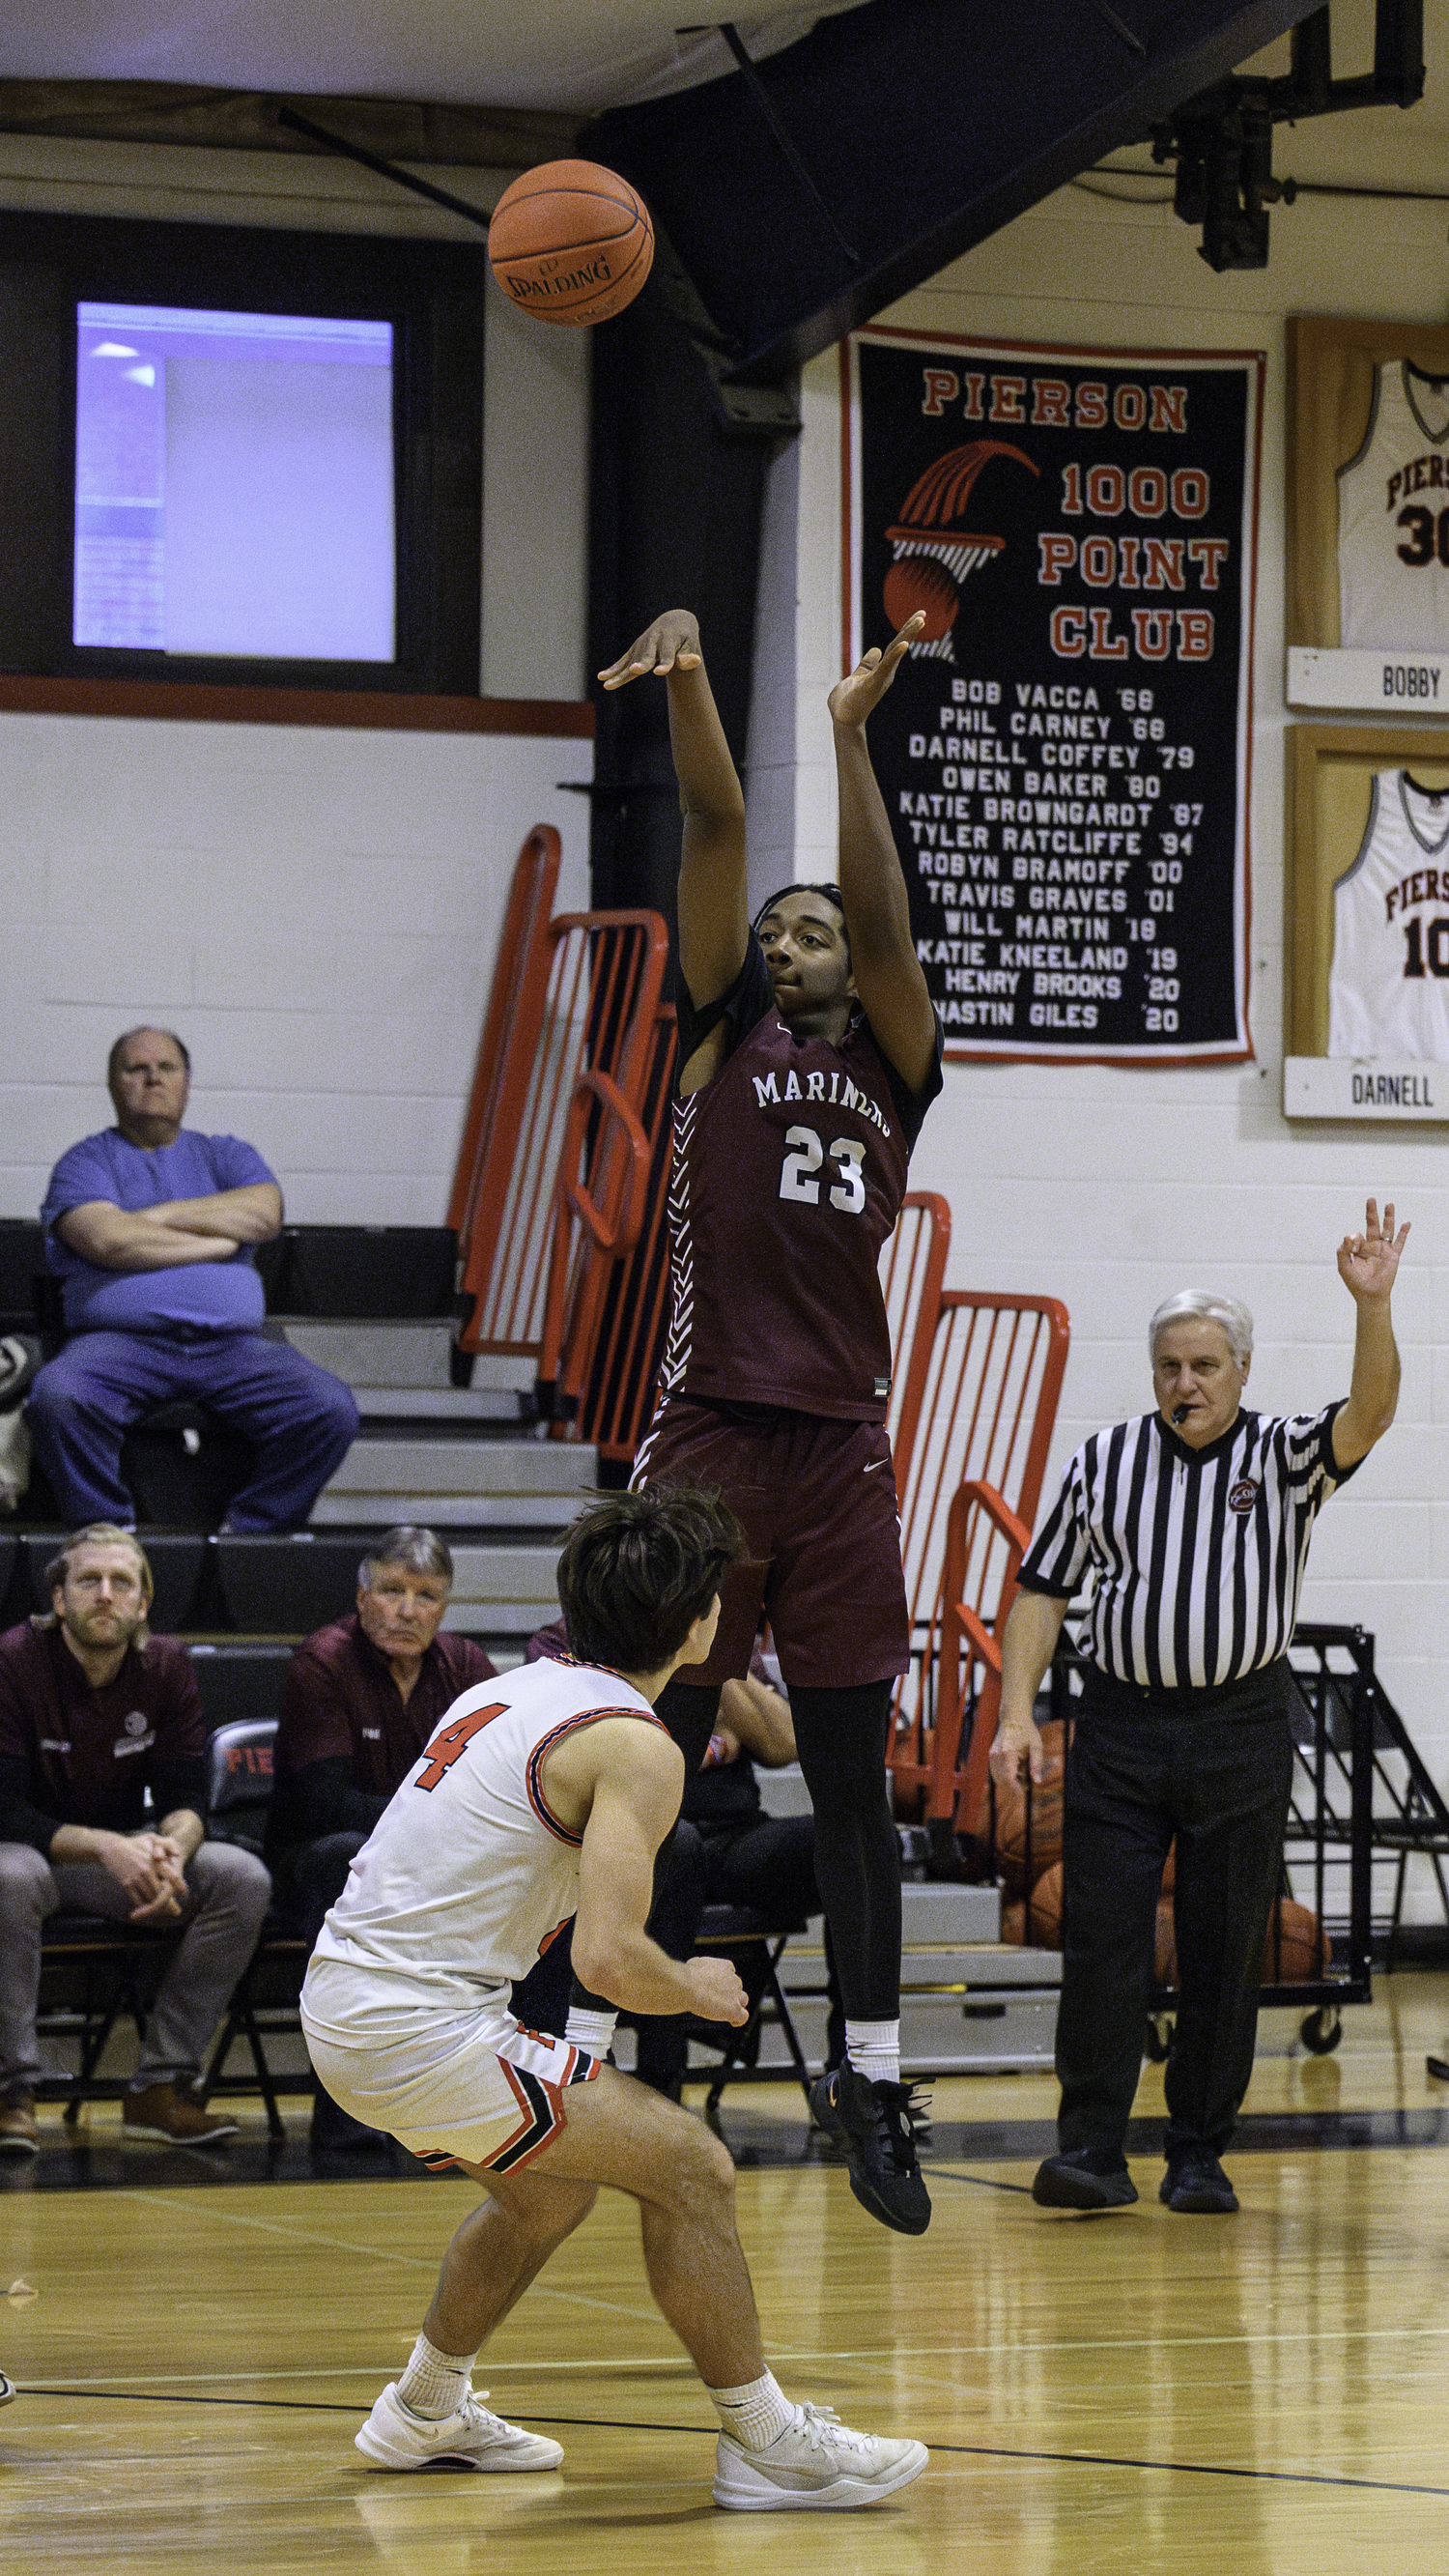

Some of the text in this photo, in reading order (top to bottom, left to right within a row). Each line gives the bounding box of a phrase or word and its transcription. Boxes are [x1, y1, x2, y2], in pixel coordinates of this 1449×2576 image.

[507, 255, 611, 298] SPALDING
[923, 368, 1187, 433] PIERSON
[1062, 463, 1209, 520] 1000
[1386, 454, 1449, 513] PIER
[1038, 532, 1229, 590] POINT
[1050, 605, 1214, 661] CLUB
[952, 678, 1001, 705] BOB
[1015, 683, 1099, 710] VACCA
[1383, 665, 1439, 698] BOBBY
[940, 707, 996, 734] PHIL
[1010, 712, 1111, 739] CARNEY
[909, 734, 1027, 764] DARNELL
[1041, 741, 1139, 769] COFFEY
[943, 767, 1010, 793] OWEN
[1025, 772, 1107, 797] BAKER
[899, 791, 970, 819] KATIE
[983, 797, 1152, 826] BROWNGARDT
[909, 820, 988, 849] TYLER
[1003, 826, 1142, 855] RATCLIFFE
[919, 851, 999, 879] ROBYN
[1012, 856, 1130, 883] BRAMOFF
[926, 880, 1014, 909] TRAVIS
[1029, 886, 1127, 912] GRAVES
[946, 910, 1003, 937] WILL
[1016, 915, 1109, 941] MARTIN
[917, 939, 986, 966] KATIE
[1000, 945, 1128, 970] KNEELAND
[945, 968, 1020, 995] HENRY
[1034, 973, 1122, 1000] BROOKS
[1030, 1004, 1098, 1029] GILES
[1352, 1073, 1434, 1106] DARNELL
[780, 1126, 867, 1214] 23
[413, 1703, 512, 1792] 4
